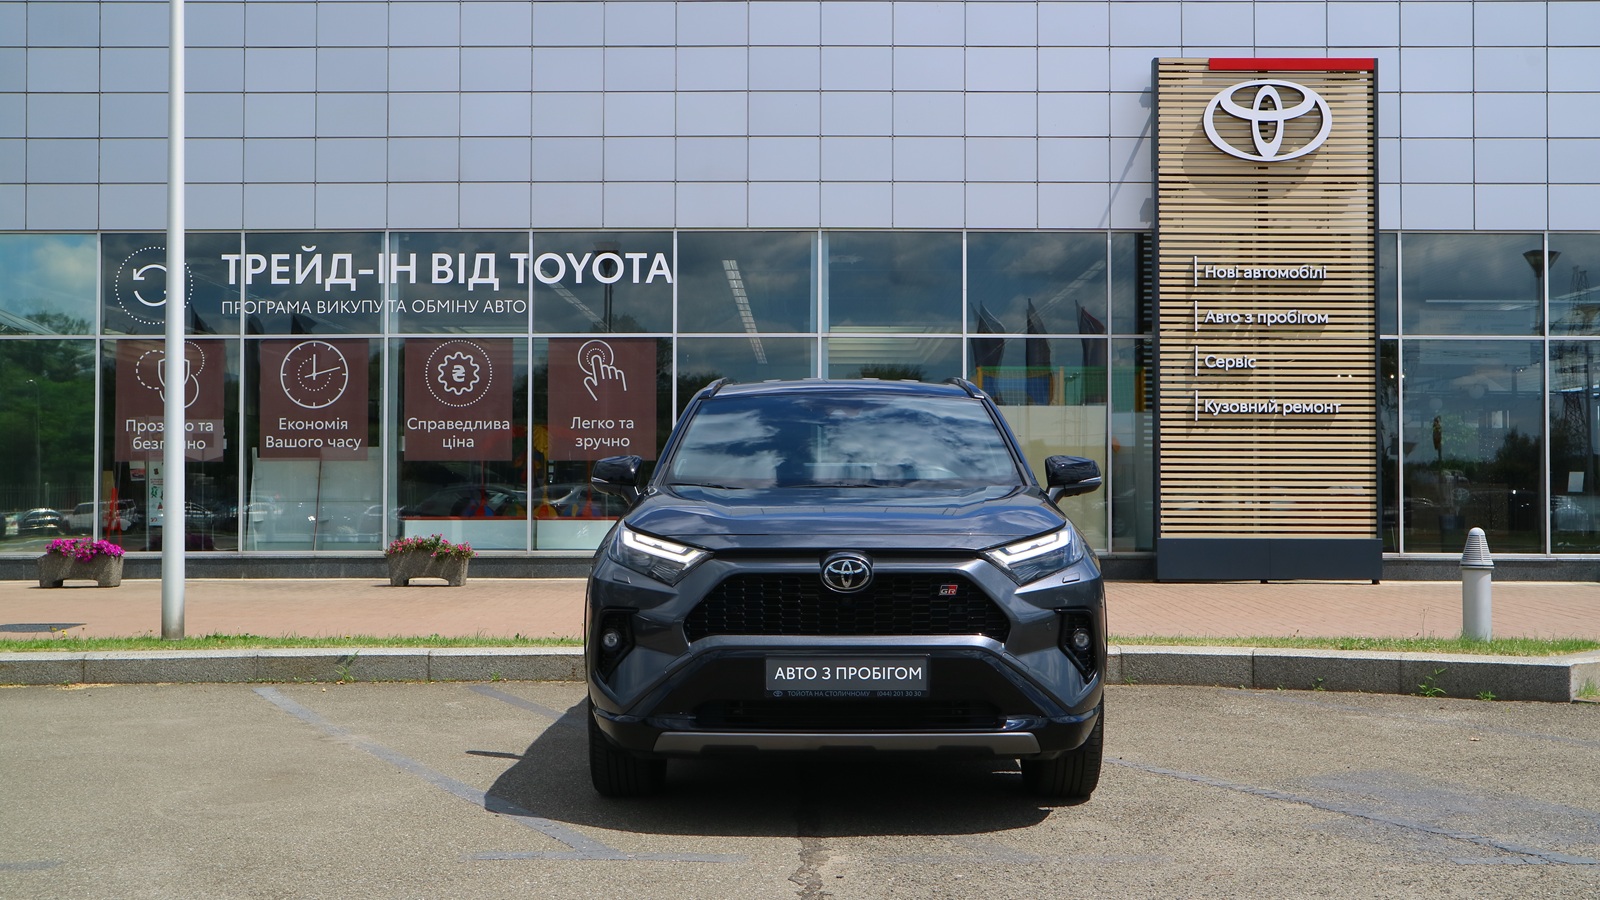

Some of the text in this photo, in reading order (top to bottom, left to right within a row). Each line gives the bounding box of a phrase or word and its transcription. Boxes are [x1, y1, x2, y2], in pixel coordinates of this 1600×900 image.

[221, 245, 674, 291] ТРЕЙД-ІН ВІД TOYOTA
[1205, 265, 1327, 279] Нові автомобілі
[222, 299, 527, 315] ПРОГРАМА ВИКУПУ ТА ОБМІНУ АВТО
[1204, 310, 1329, 326] Авто з пробігом
[1204, 355, 1257, 371] Сервіс
[1204, 399, 1341, 416] Кузовний ремонт
[125, 419, 214, 435] Прозо та
[279, 417, 348, 430] Економія
[407, 417, 510, 436] Справедлива
[570, 417, 634, 429] Легко та
[132, 437, 206, 450] безпно
[266, 436, 362, 452] Вашого часу
[442, 435, 474, 450] ціна
[575, 438, 630, 452] зручно
[774, 666, 817, 680] АВТО
[836, 666, 922, 680] ПРОБІГОМ
[877, 690, 892, 698] (044)
